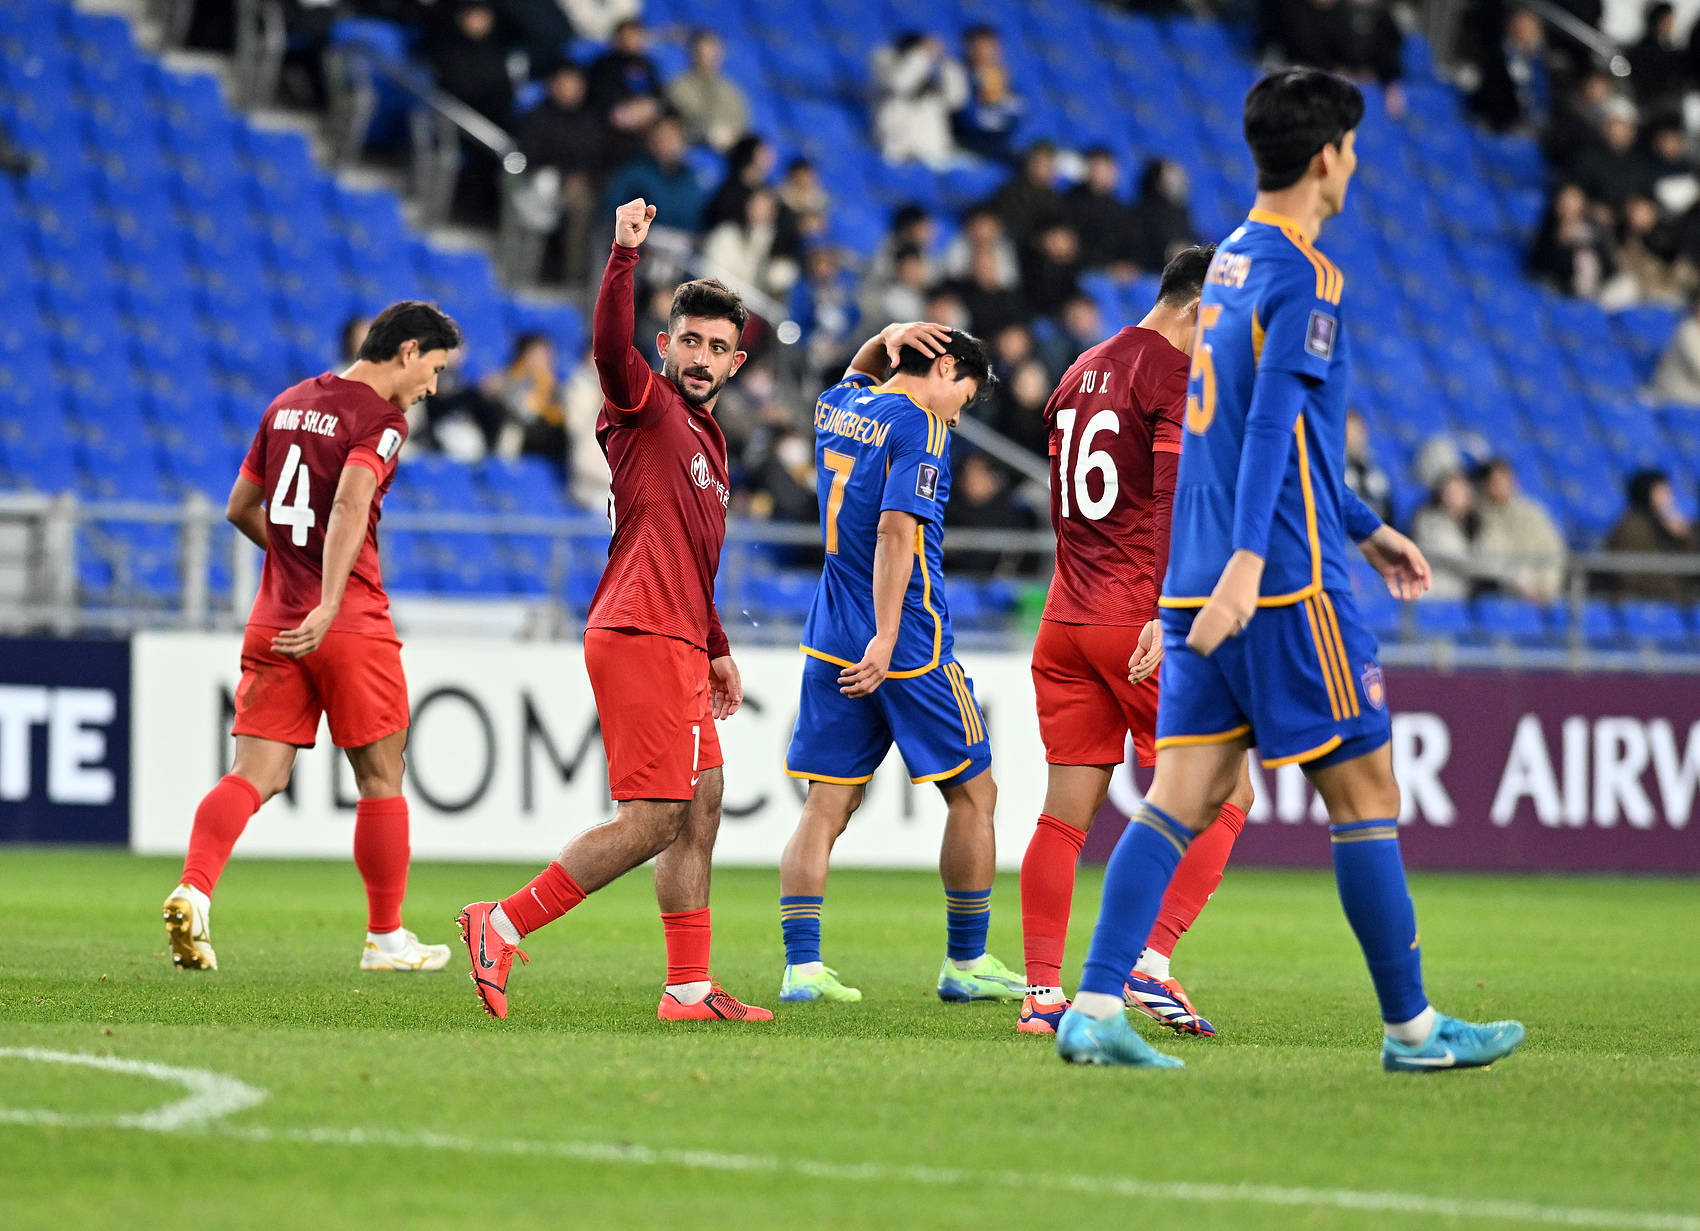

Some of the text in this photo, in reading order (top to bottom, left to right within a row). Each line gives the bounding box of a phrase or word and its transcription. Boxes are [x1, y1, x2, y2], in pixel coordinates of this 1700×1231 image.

[1079, 370, 1097, 393] XU
[1186, 304, 1217, 436] 5
[270, 444, 315, 546] 4
[824, 448, 856, 555] 7
[1056, 408, 1120, 520] 16
[0, 683, 117, 806] TE
